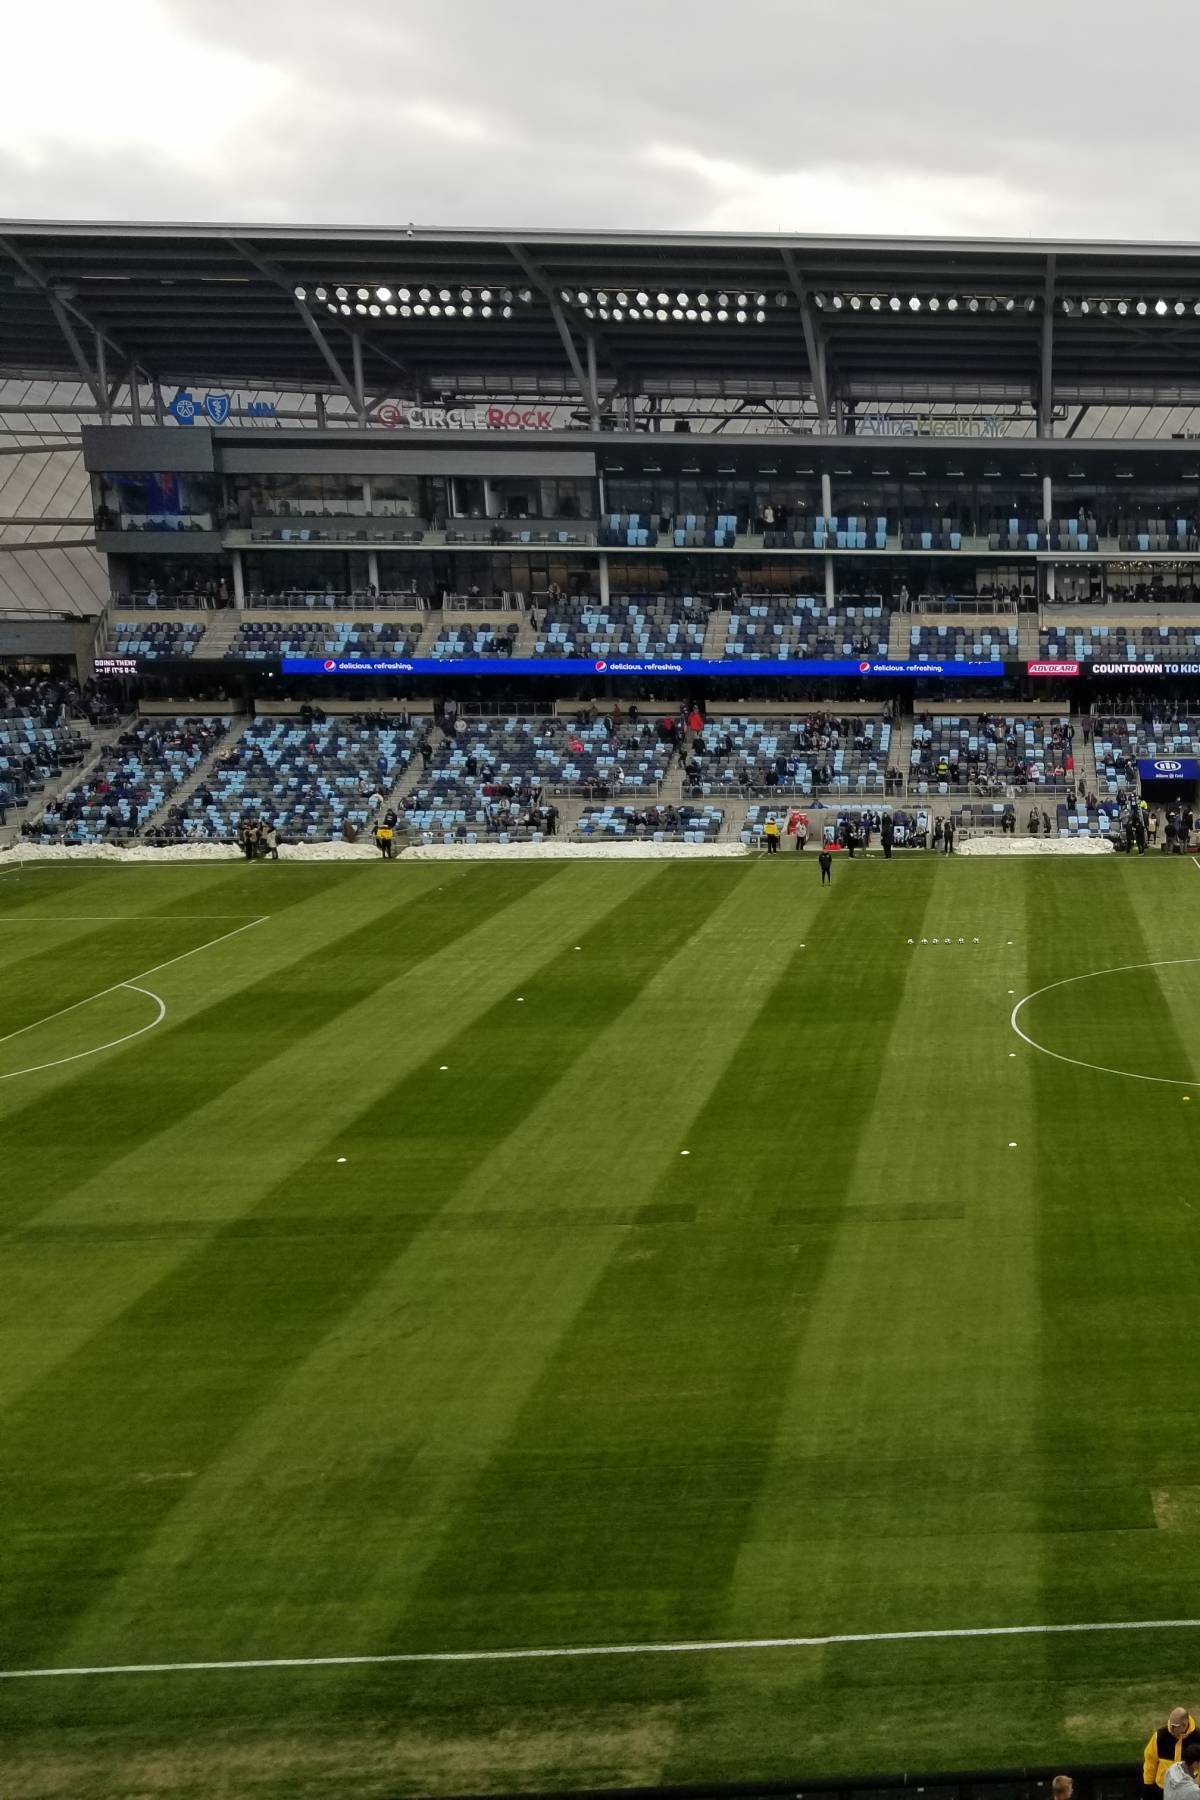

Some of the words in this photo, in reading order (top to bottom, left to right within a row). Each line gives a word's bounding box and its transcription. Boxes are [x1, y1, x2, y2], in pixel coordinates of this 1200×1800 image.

[859, 414, 914, 435] Allina
[917, 414, 980, 435] Health
[374, 662, 413, 670] refreshing.
[644, 663, 683, 671] refreshing.
[1030, 664, 1077, 672] ADVOCARE
[1092, 664, 1162, 673] COUNTDOWN
[1164, 664, 1179, 673] TO
